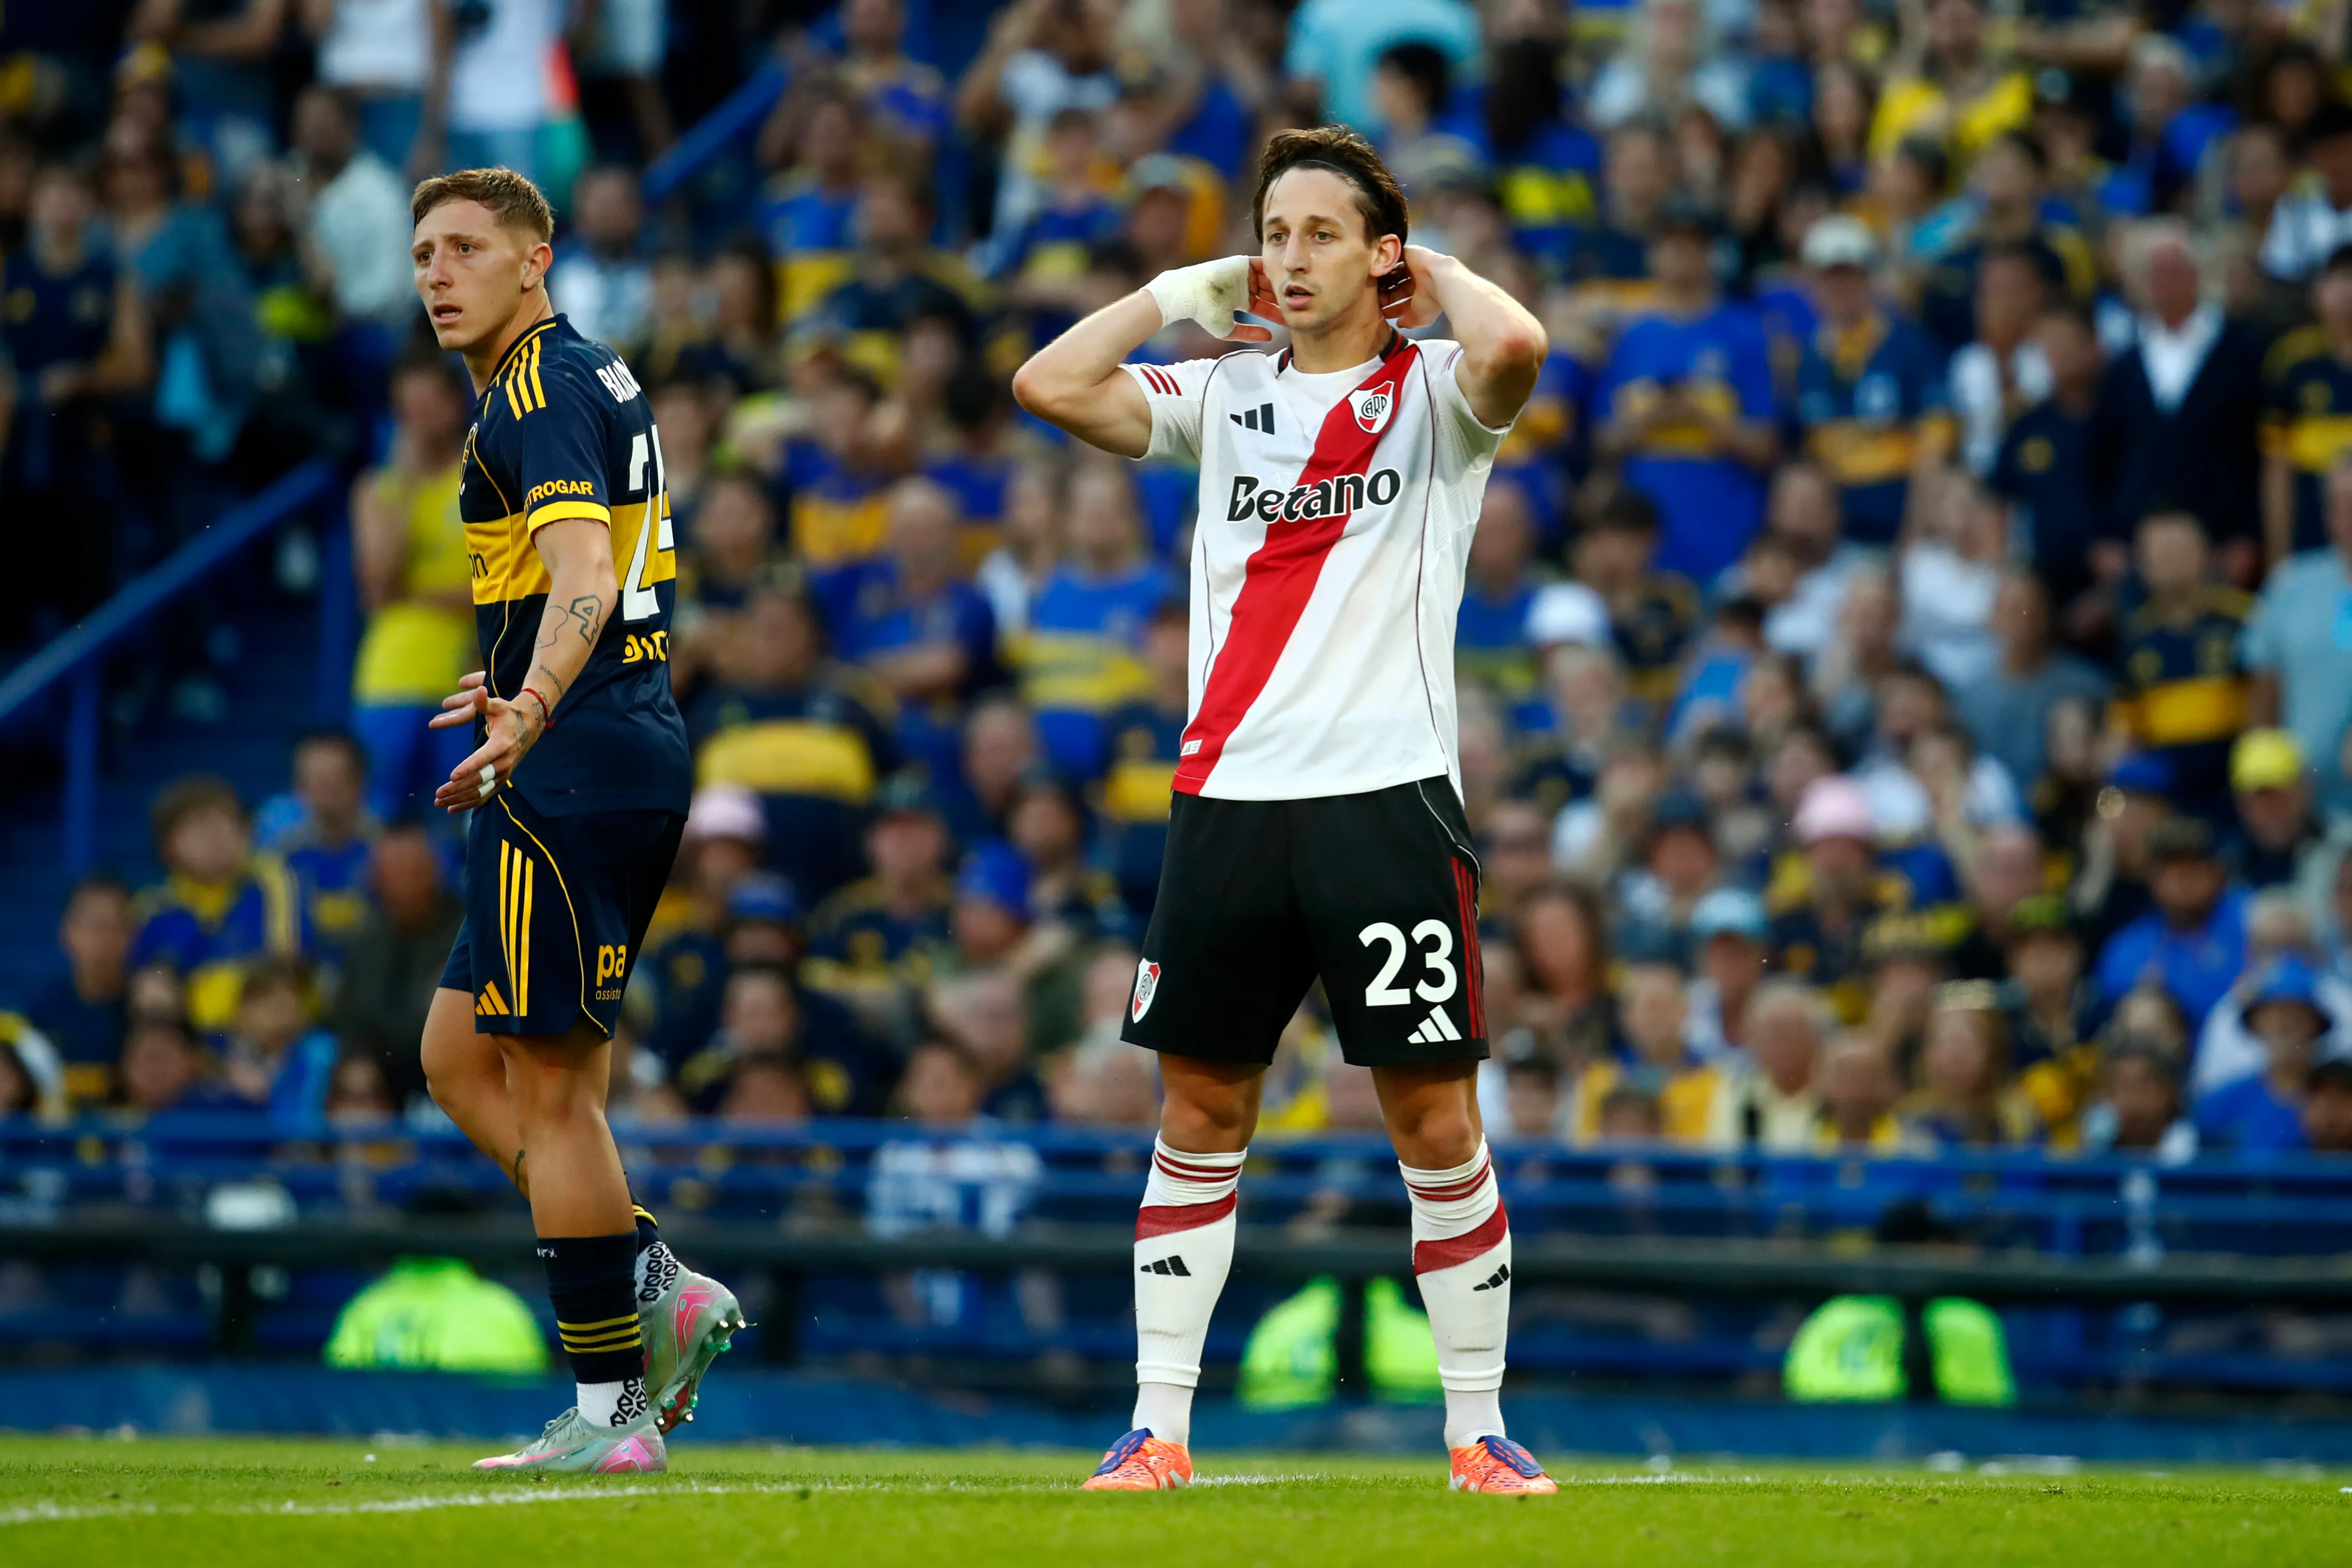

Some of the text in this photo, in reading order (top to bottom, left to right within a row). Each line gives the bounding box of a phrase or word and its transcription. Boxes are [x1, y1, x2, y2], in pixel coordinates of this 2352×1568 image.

[1224, 467, 1403, 524] Betano
[596, 944, 626, 986] pa
[1358, 919, 1457, 1006] 23
